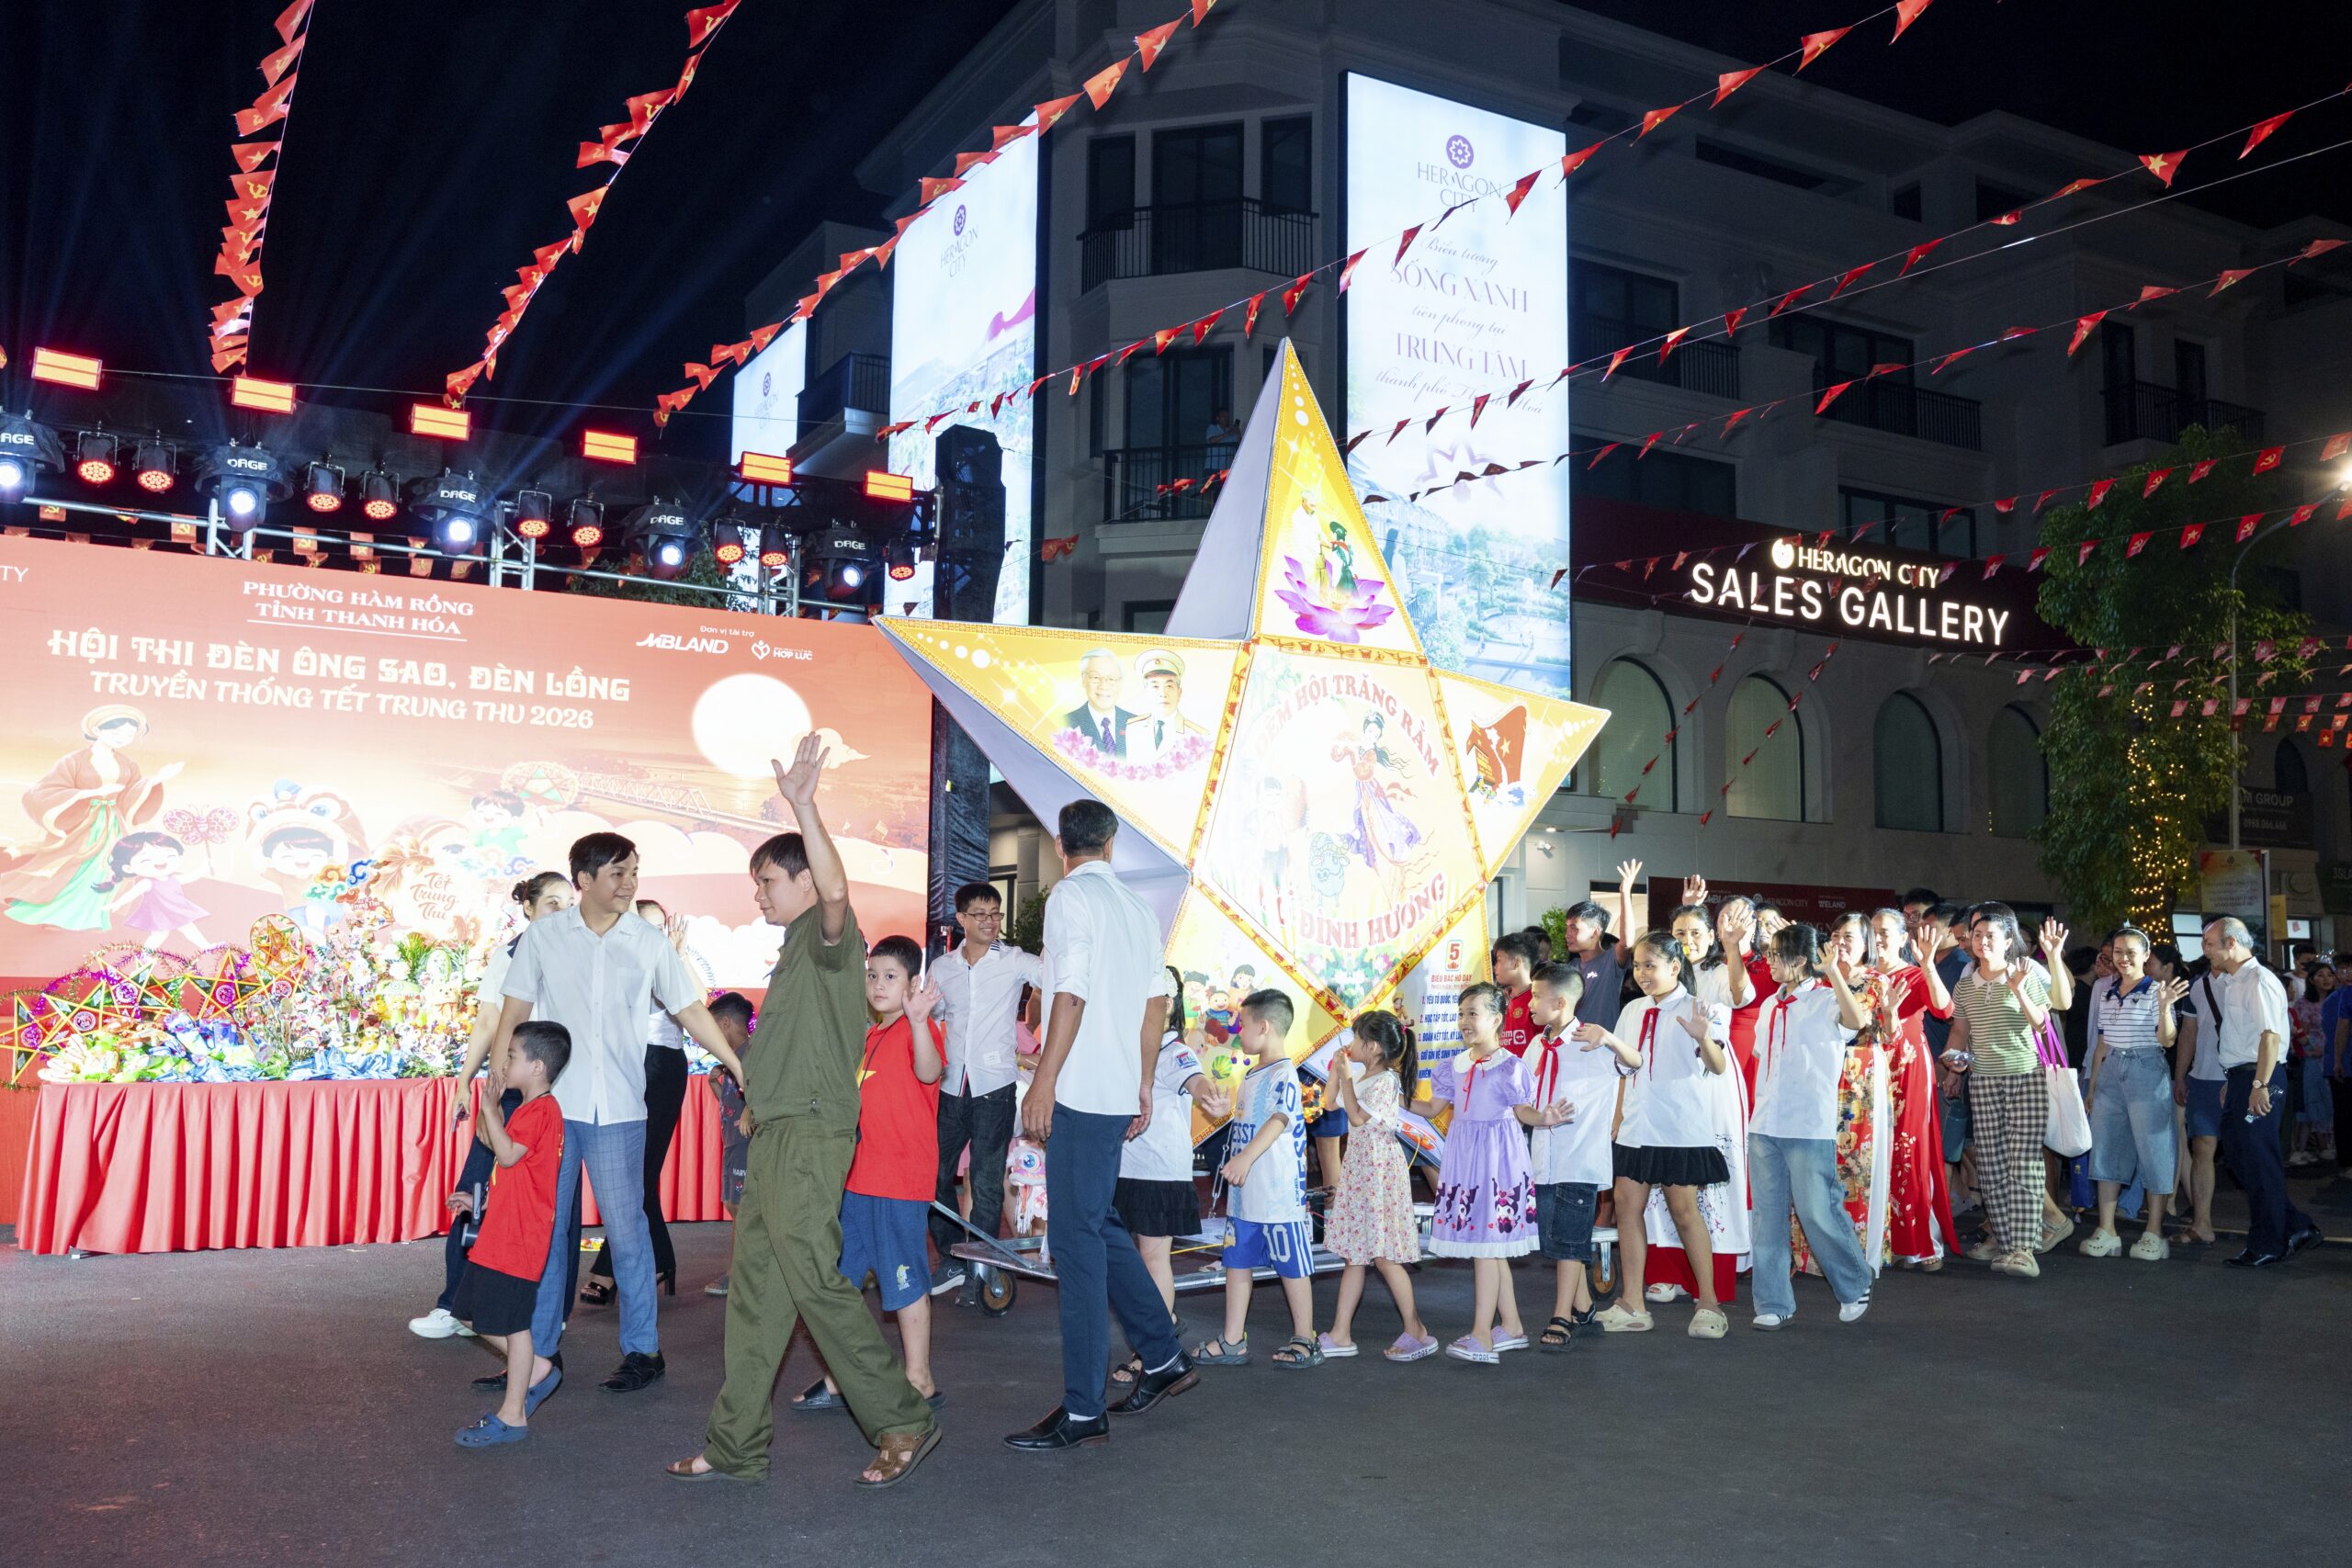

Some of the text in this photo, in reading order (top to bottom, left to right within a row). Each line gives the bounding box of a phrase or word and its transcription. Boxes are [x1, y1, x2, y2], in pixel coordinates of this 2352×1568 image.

[1418, 162, 1502, 198] HERAGON
[1440, 188, 1477, 213] CITY
[1390, 258, 1528, 312] SỐNG XANH
[1396, 332, 1526, 381] TRUNG TÂM
[0, 432, 35, 446] AGE
[227, 457, 268, 471] DAGE
[440, 489, 478, 503] DAGE
[650, 514, 684, 525] DAGE
[834, 539, 866, 550] DAGE
[0, 565, 29, 582] TY
[1798, 547, 1891, 581] HERAGON
[243, 581, 474, 616] PHƯỜNG HÀM RỒNG
[1691, 562, 2009, 646] SALES GALLERY
[255, 600, 461, 635] TỈNH THANH HÓA
[700, 625, 718, 635] Đơn
[636, 632, 729, 654] MBLAND
[47, 626, 630, 701] HỘI THI ĐÈN ÔNG SAO, ĐÈN LỒNG
[90, 668, 594, 729] TRUYỀN THỐNG TẾT TRUNG THU 2026
[1295, 674, 1329, 712] HỘI
[1332, 673, 1397, 716] TRĂNG
[1400, 708, 1440, 776] RẰM
[2256, 792, 2294, 807] GROUP
[424, 872, 453, 891] Tết
[410, 883, 457, 911] Trung
[418, 901, 448, 919] Thu
[1300, 873, 1445, 949] ĐÌNH HƯƠNG
[1450, 942, 1460, 961] 5
[1262, 1224, 1292, 1264] 10
